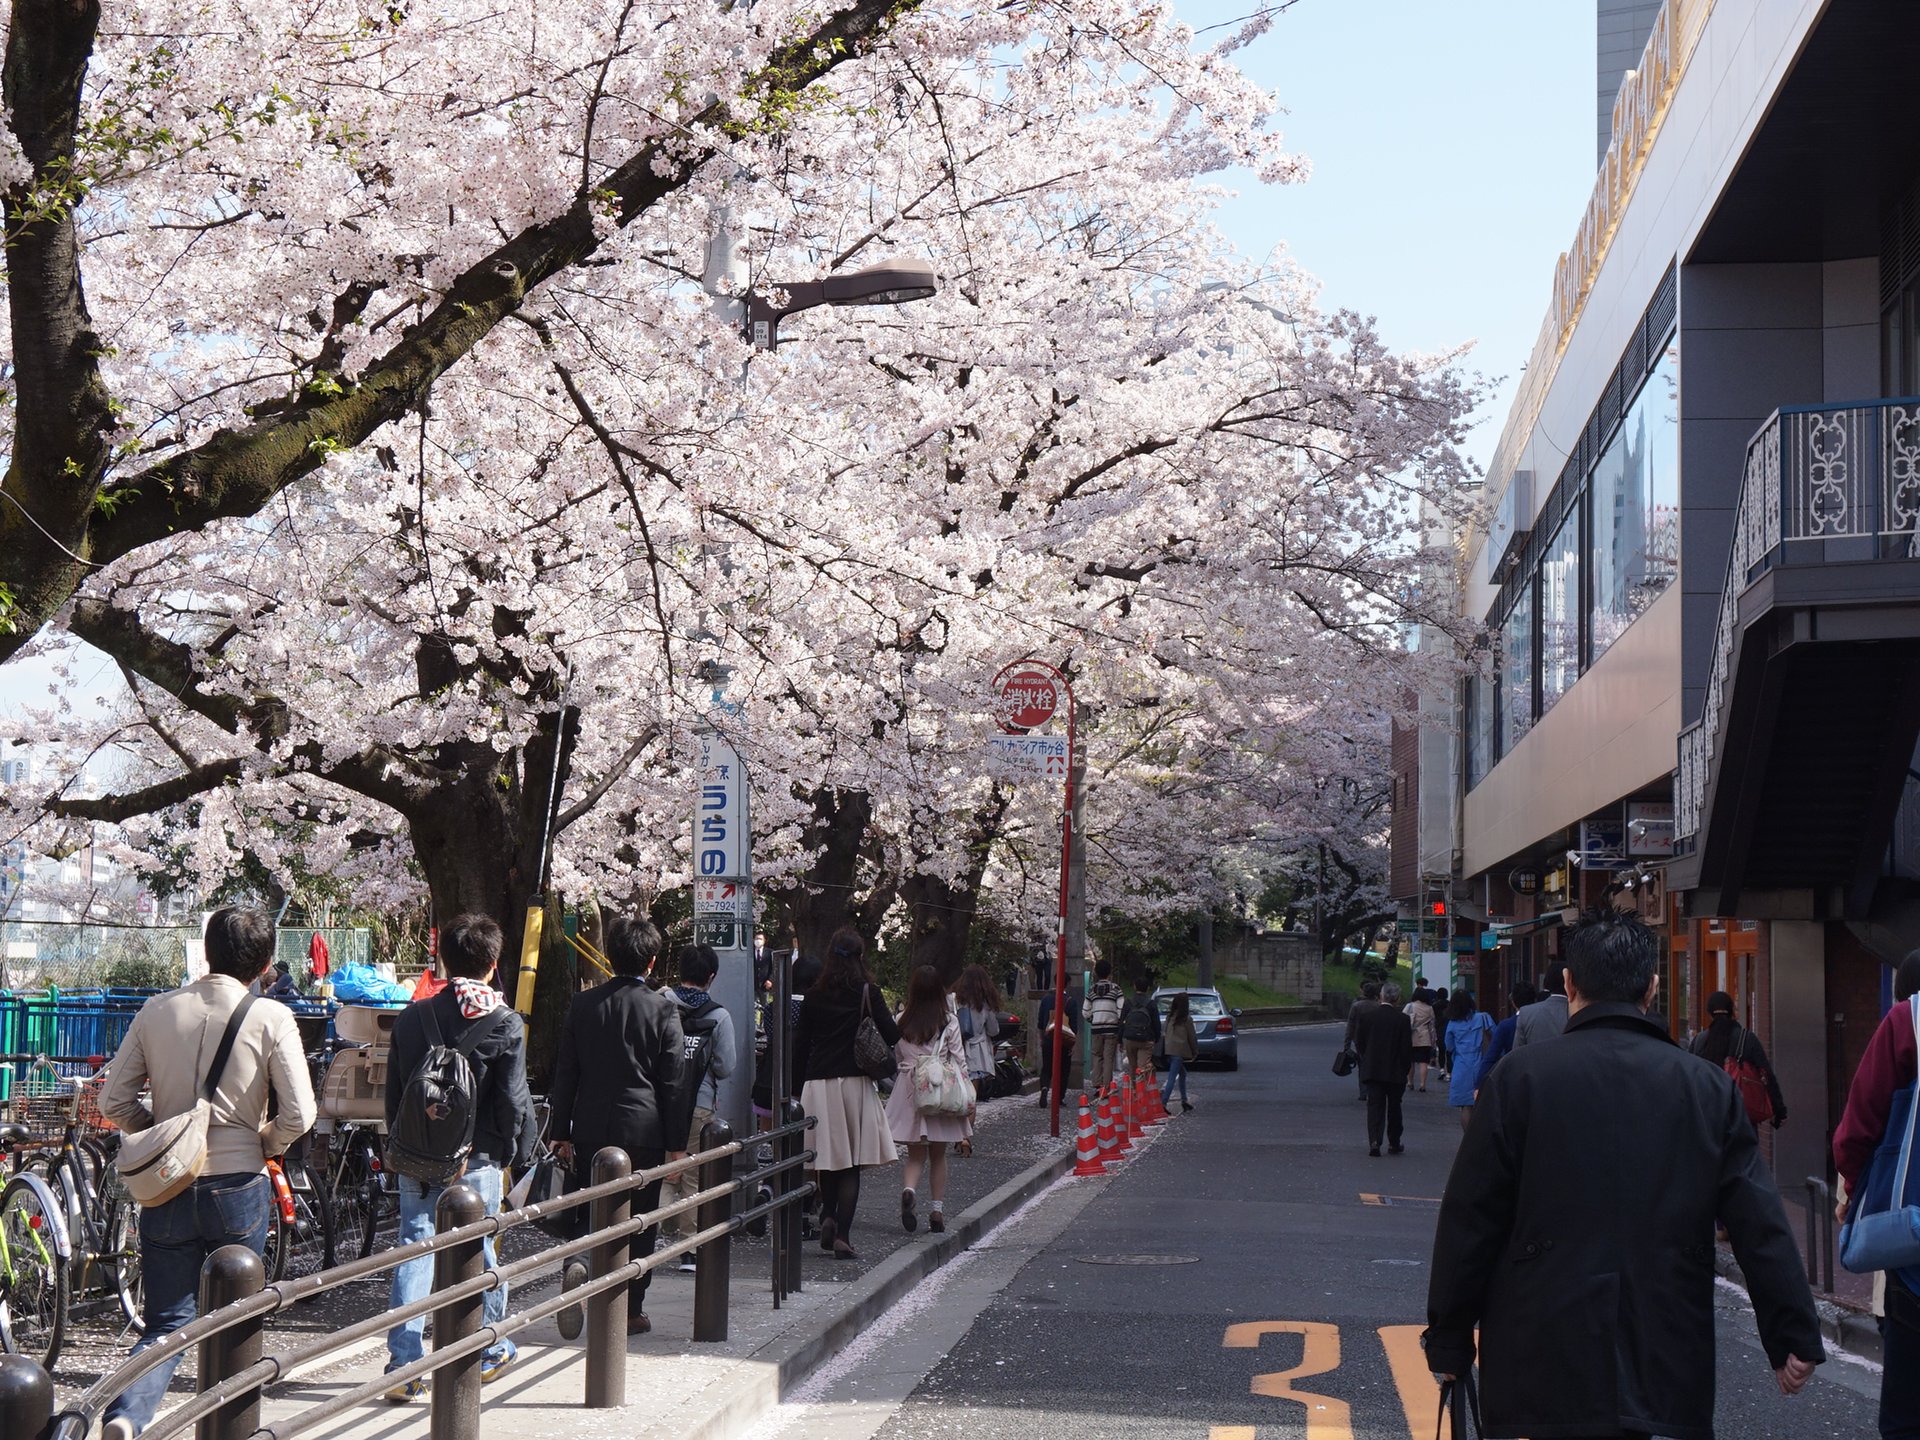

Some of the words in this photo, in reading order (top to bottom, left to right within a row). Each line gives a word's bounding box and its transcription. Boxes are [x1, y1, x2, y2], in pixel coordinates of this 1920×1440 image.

[1006, 688, 1054, 712] 消火栓
[701, 785, 727, 875] うちの
[699, 923, 728, 933] 九段北
[702, 936, 723, 945] 4-4
